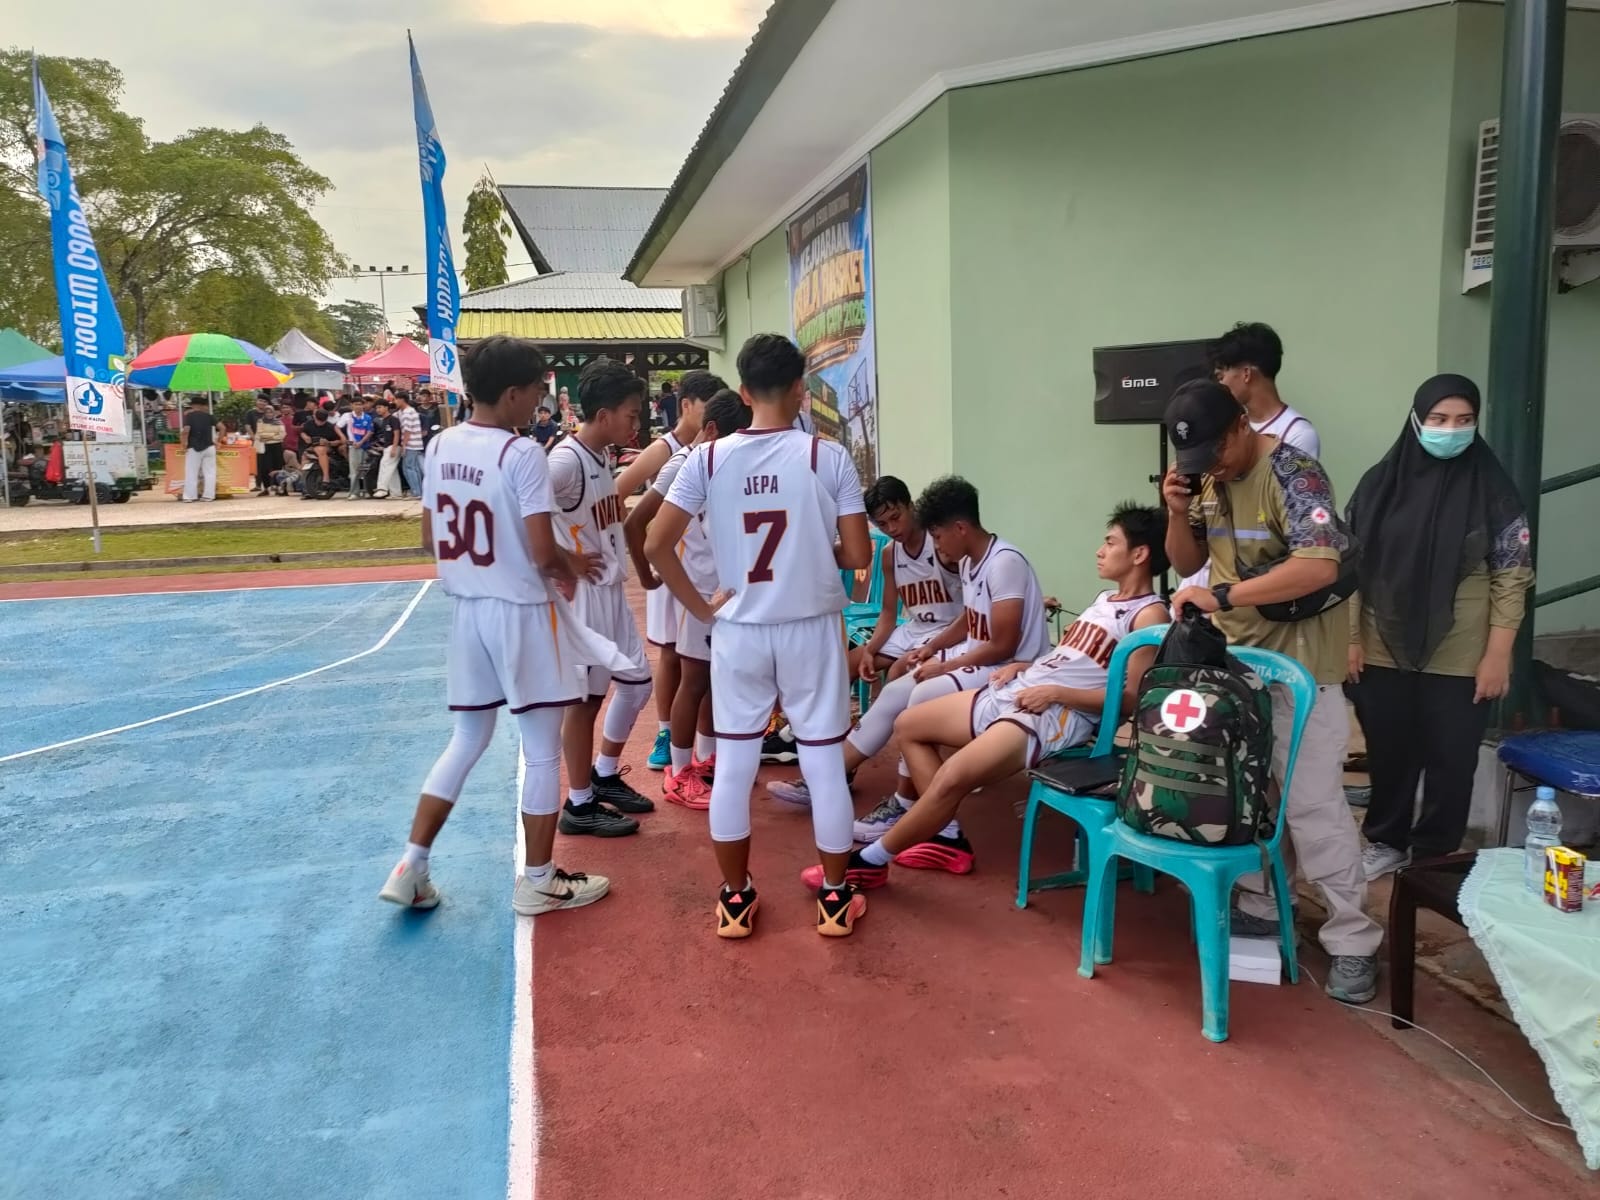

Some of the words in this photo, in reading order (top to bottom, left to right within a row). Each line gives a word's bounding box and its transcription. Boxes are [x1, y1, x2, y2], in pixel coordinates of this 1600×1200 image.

[800, 222, 850, 277] KEJUARAAN
[66, 273, 99, 359] KODIM
[744, 475, 779, 496] JEPA
[436, 492, 495, 567] 30
[742, 509, 788, 584] 7
